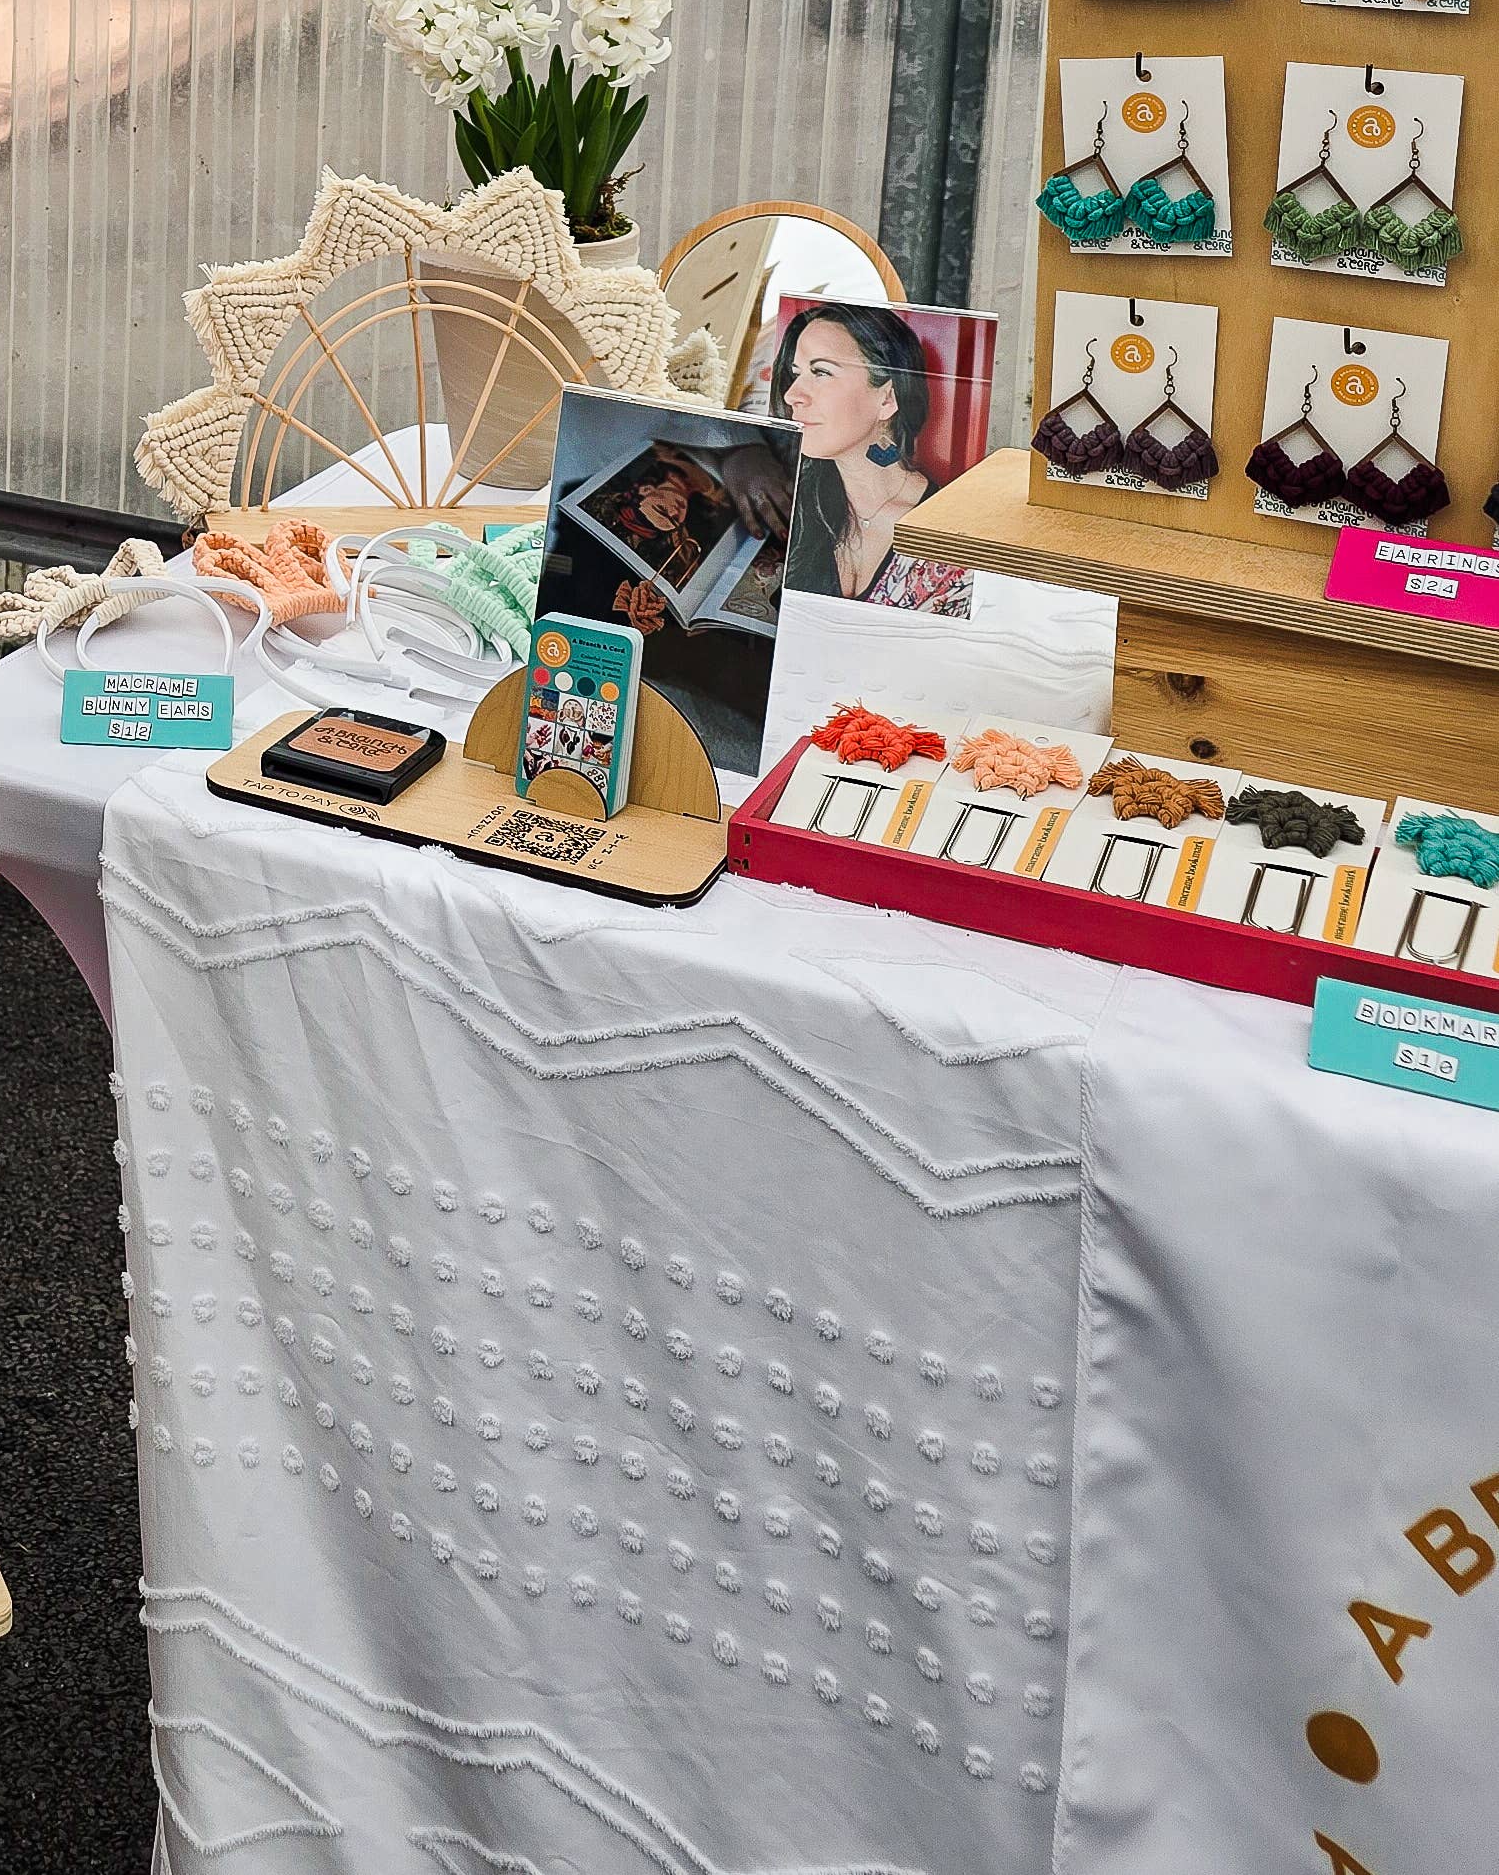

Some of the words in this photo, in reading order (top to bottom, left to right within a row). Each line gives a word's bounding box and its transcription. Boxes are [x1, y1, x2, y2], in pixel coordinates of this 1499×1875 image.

[1411, 579, 1454, 594] $24
[106, 678, 195, 693] MACRAME
[85, 701, 148, 711] BUNNY
[160, 704, 210, 716] EARS
[111, 723, 147, 737] $12
[318, 736, 333, 744] &
[243, 779, 275, 791] TAP
[278, 788, 300, 798] TO
[302, 794, 338, 807] PAY
[893, 814, 909, 845] macrame
[905, 783, 924, 816] bookmark
[1025, 843, 1044, 873] macrame
[1040, 811, 1060, 844] bookmark
[1178, 875, 1194, 907] macrame
[1187, 840, 1204, 876] bookmark
[1400, 1049, 1453, 1074] $10
[1348, 1600, 1432, 1685] A
